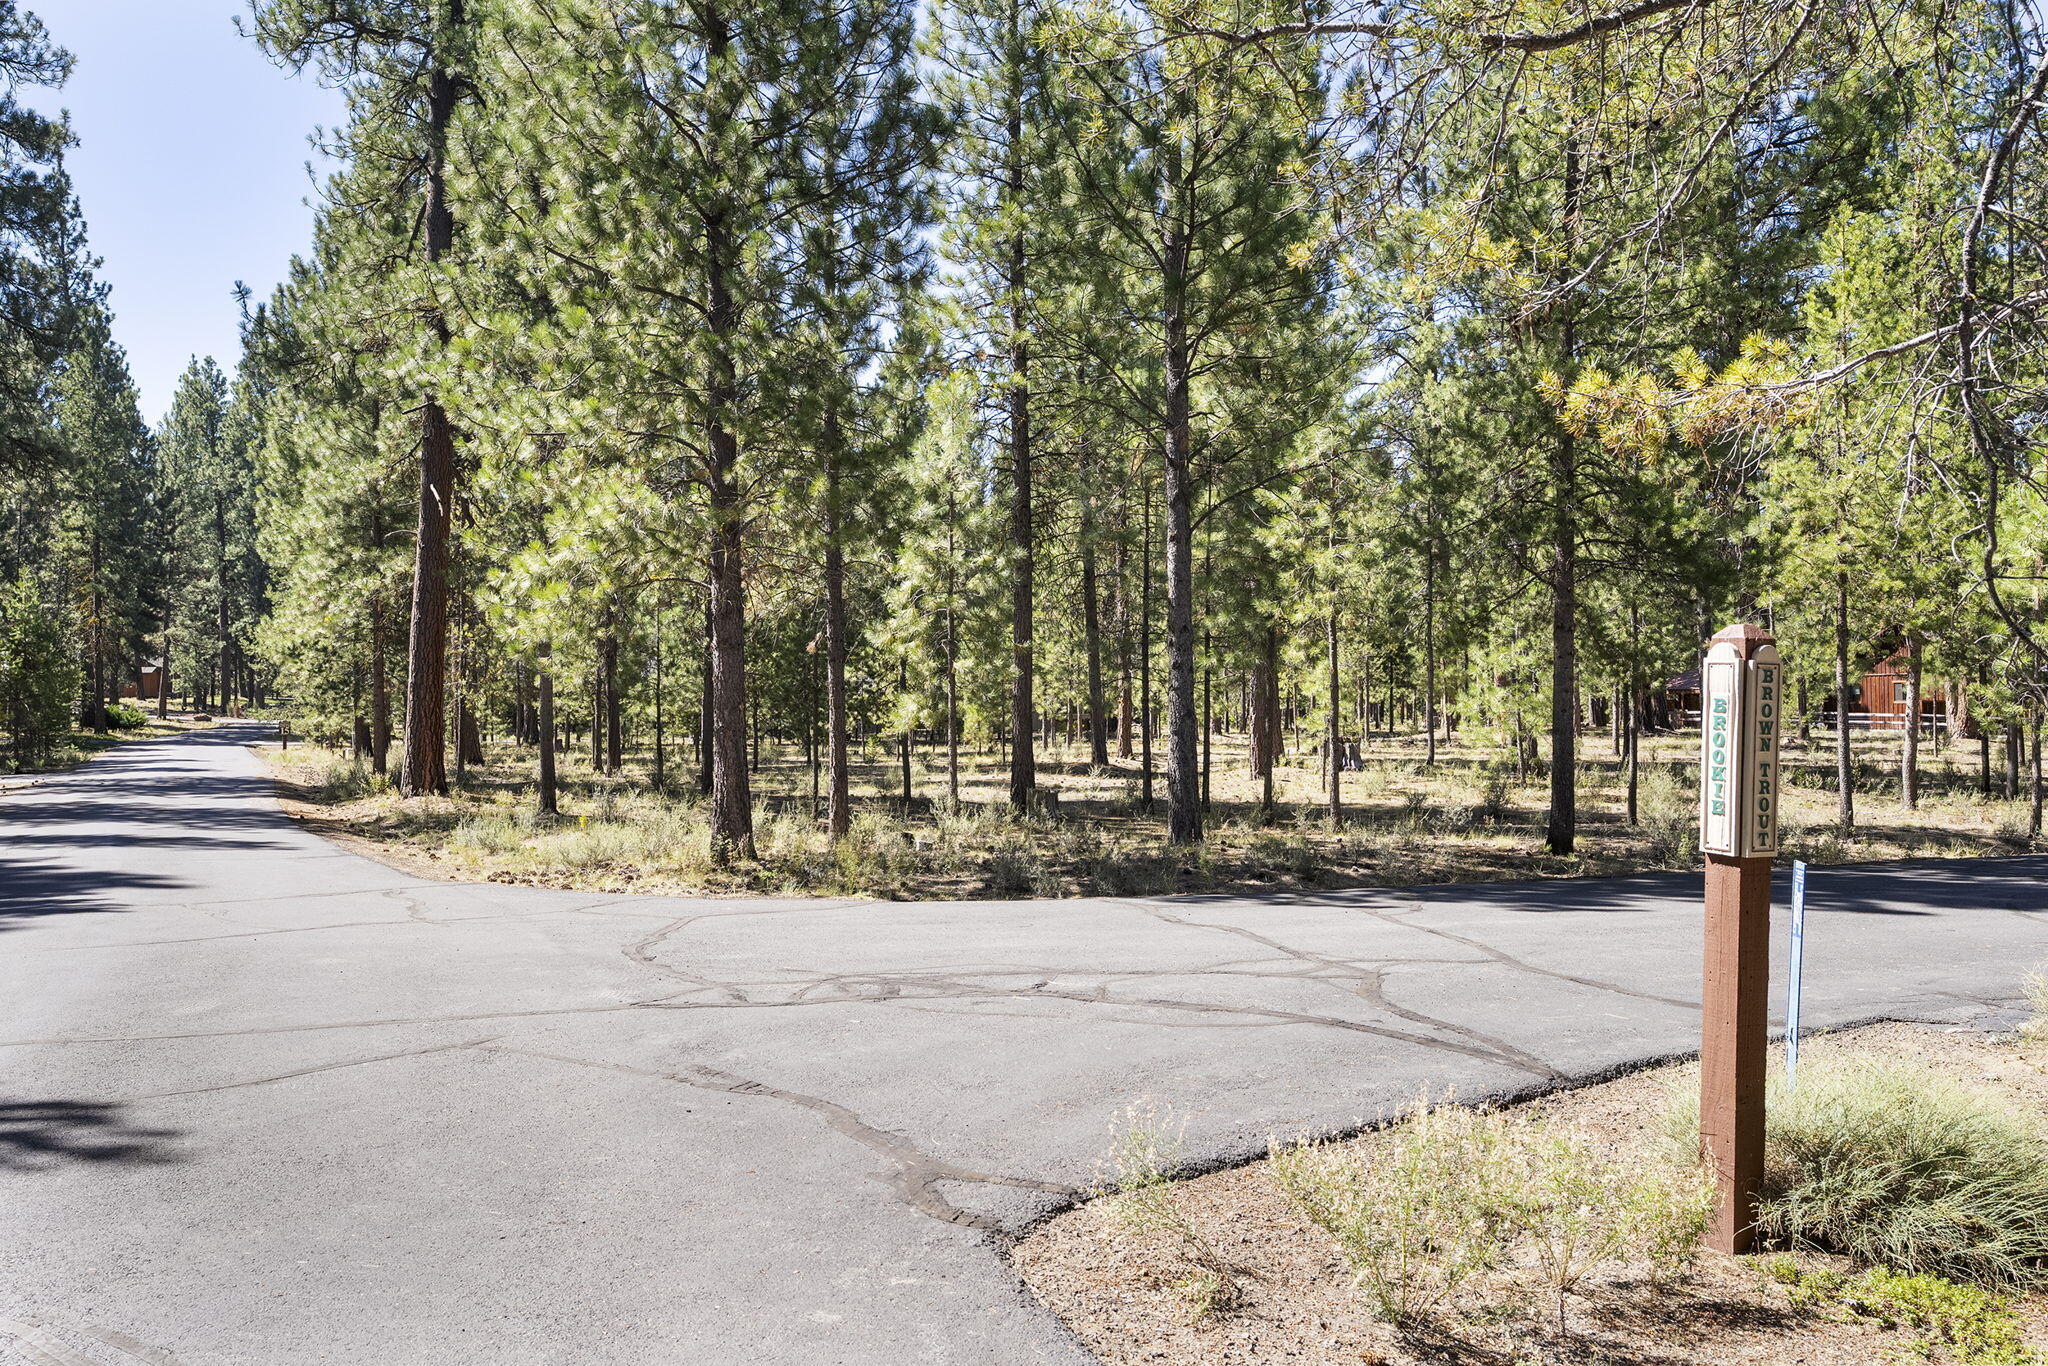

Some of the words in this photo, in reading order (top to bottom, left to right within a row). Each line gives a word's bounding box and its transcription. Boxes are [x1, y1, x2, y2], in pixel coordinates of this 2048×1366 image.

[1759, 669, 1774, 752] BROWN
[1712, 698, 1727, 816] BROOKIE
[1758, 763, 1771, 846] TROUT
